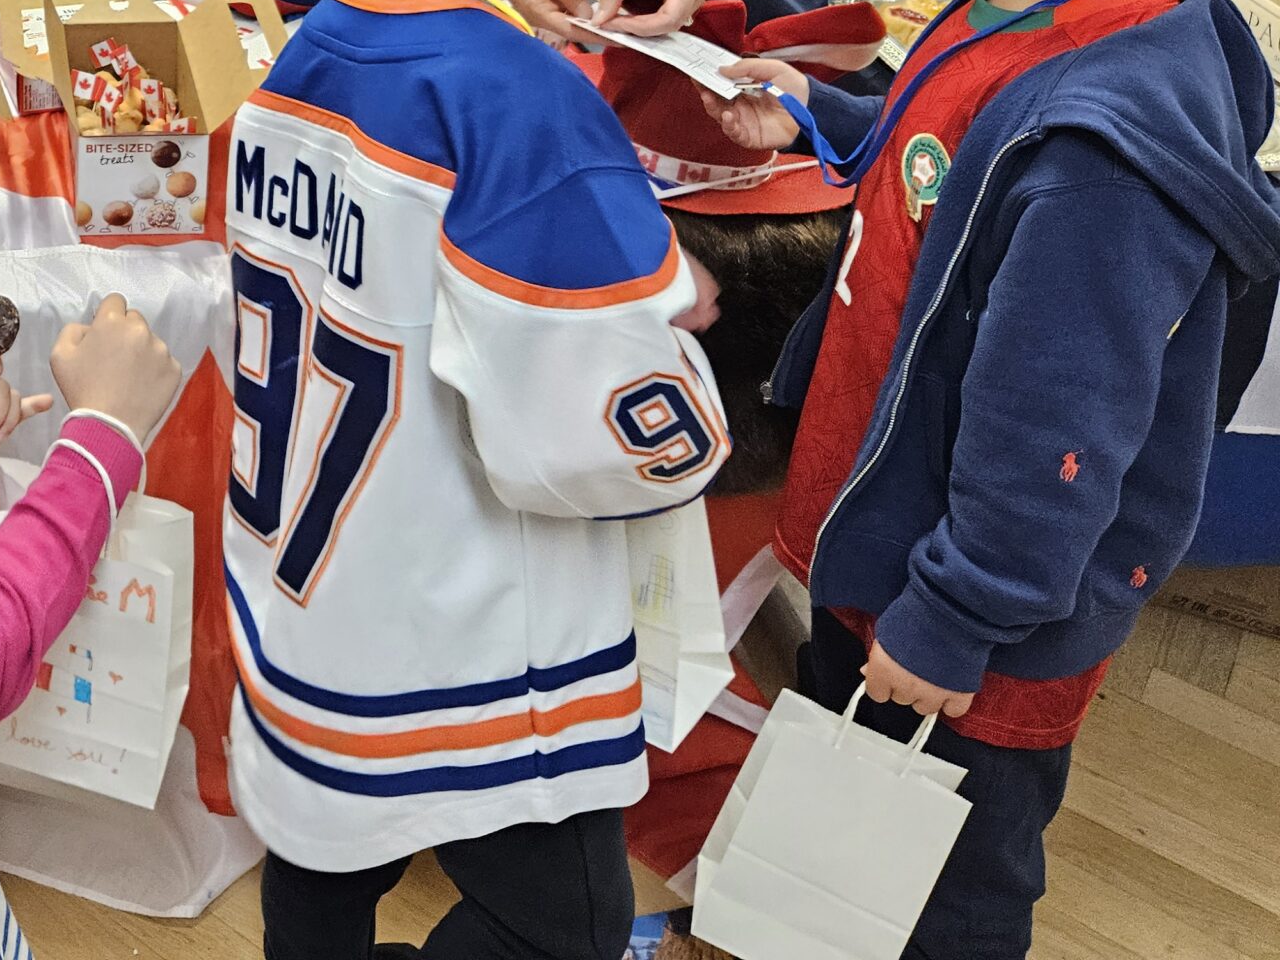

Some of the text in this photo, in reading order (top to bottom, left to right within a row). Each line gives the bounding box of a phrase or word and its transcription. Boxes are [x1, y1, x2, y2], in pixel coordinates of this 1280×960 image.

[85, 143, 154, 154] BITE-SIZED
[100, 153, 134, 166] treats
[228, 242, 404, 609] 97
[602, 371, 732, 484] 9
